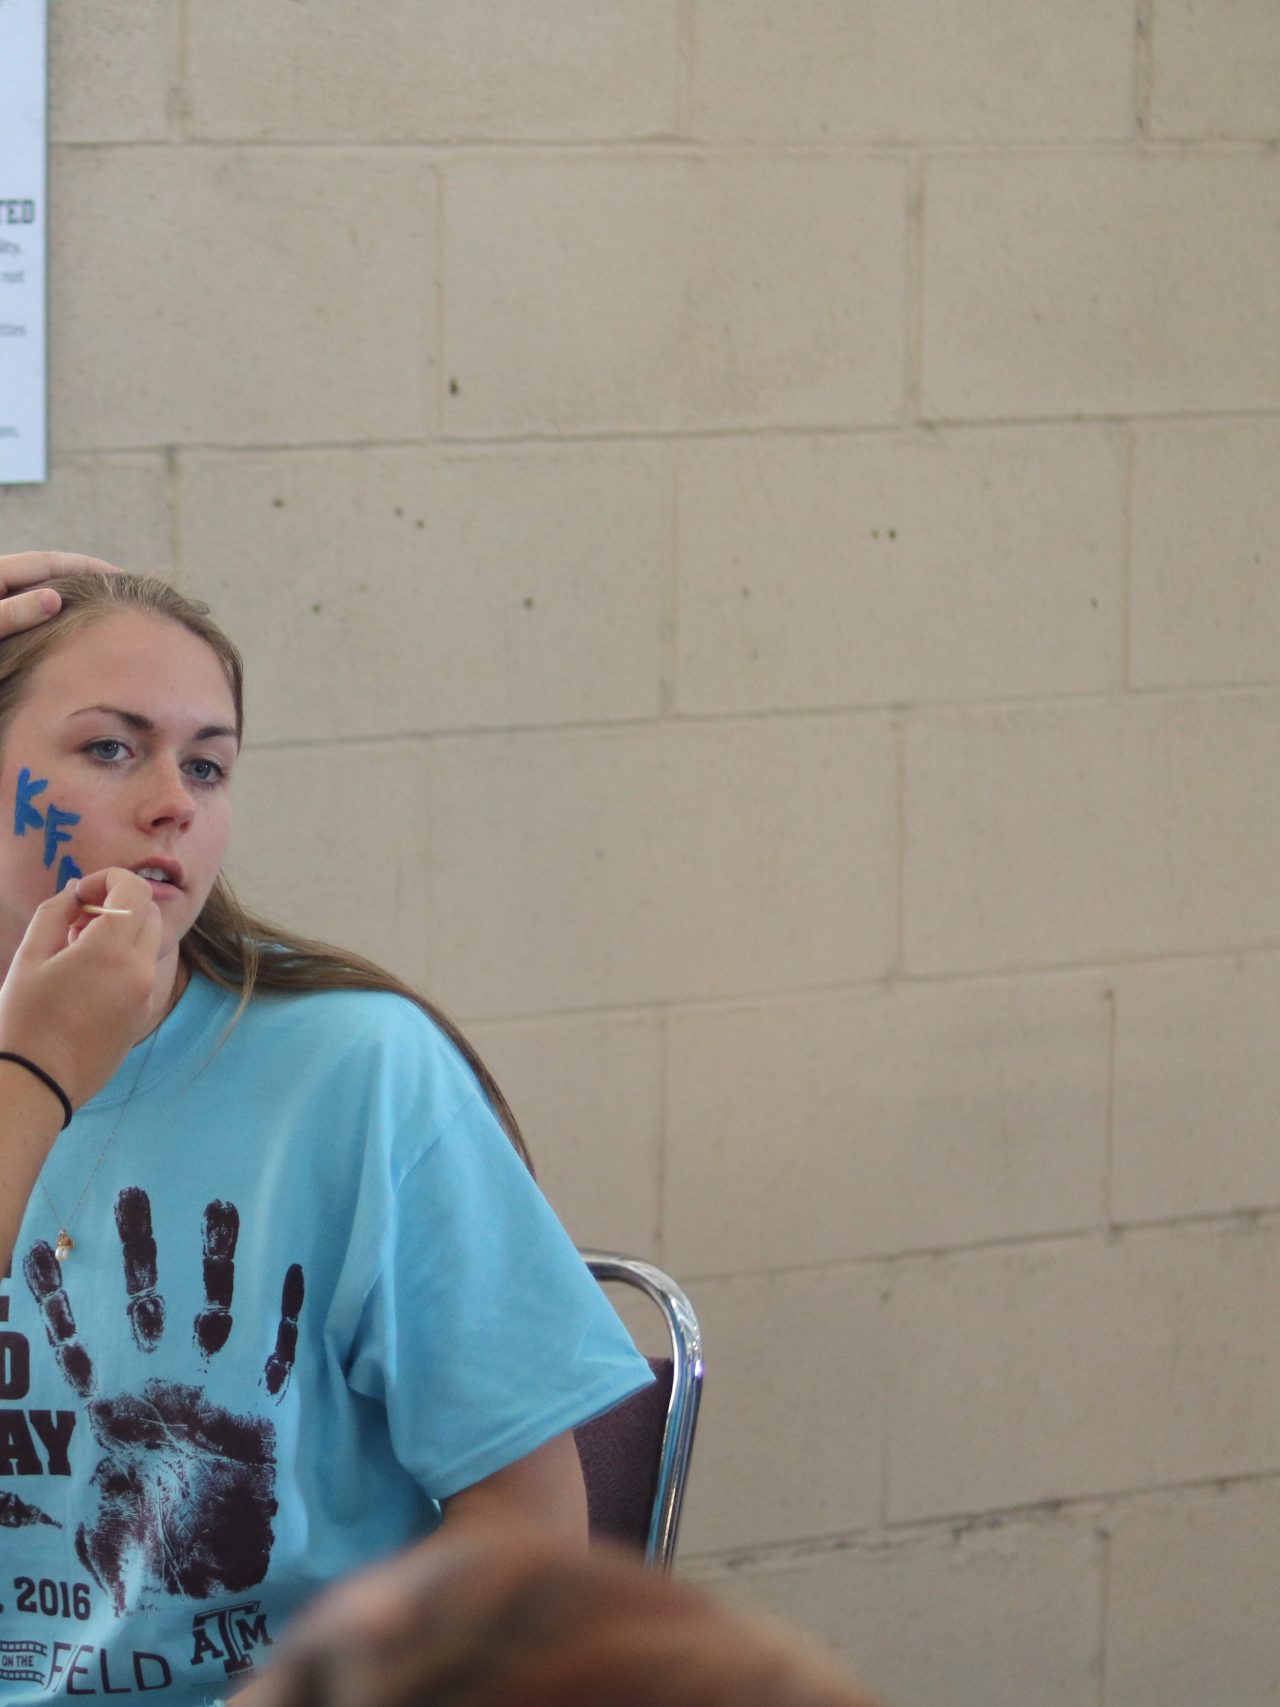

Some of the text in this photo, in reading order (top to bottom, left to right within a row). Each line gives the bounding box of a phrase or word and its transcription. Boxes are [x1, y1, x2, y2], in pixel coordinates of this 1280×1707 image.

[14, 1576, 91, 1620] 2016
[2, 1655, 14, 1667] ON
[16, 1655, 34, 1668] THE
